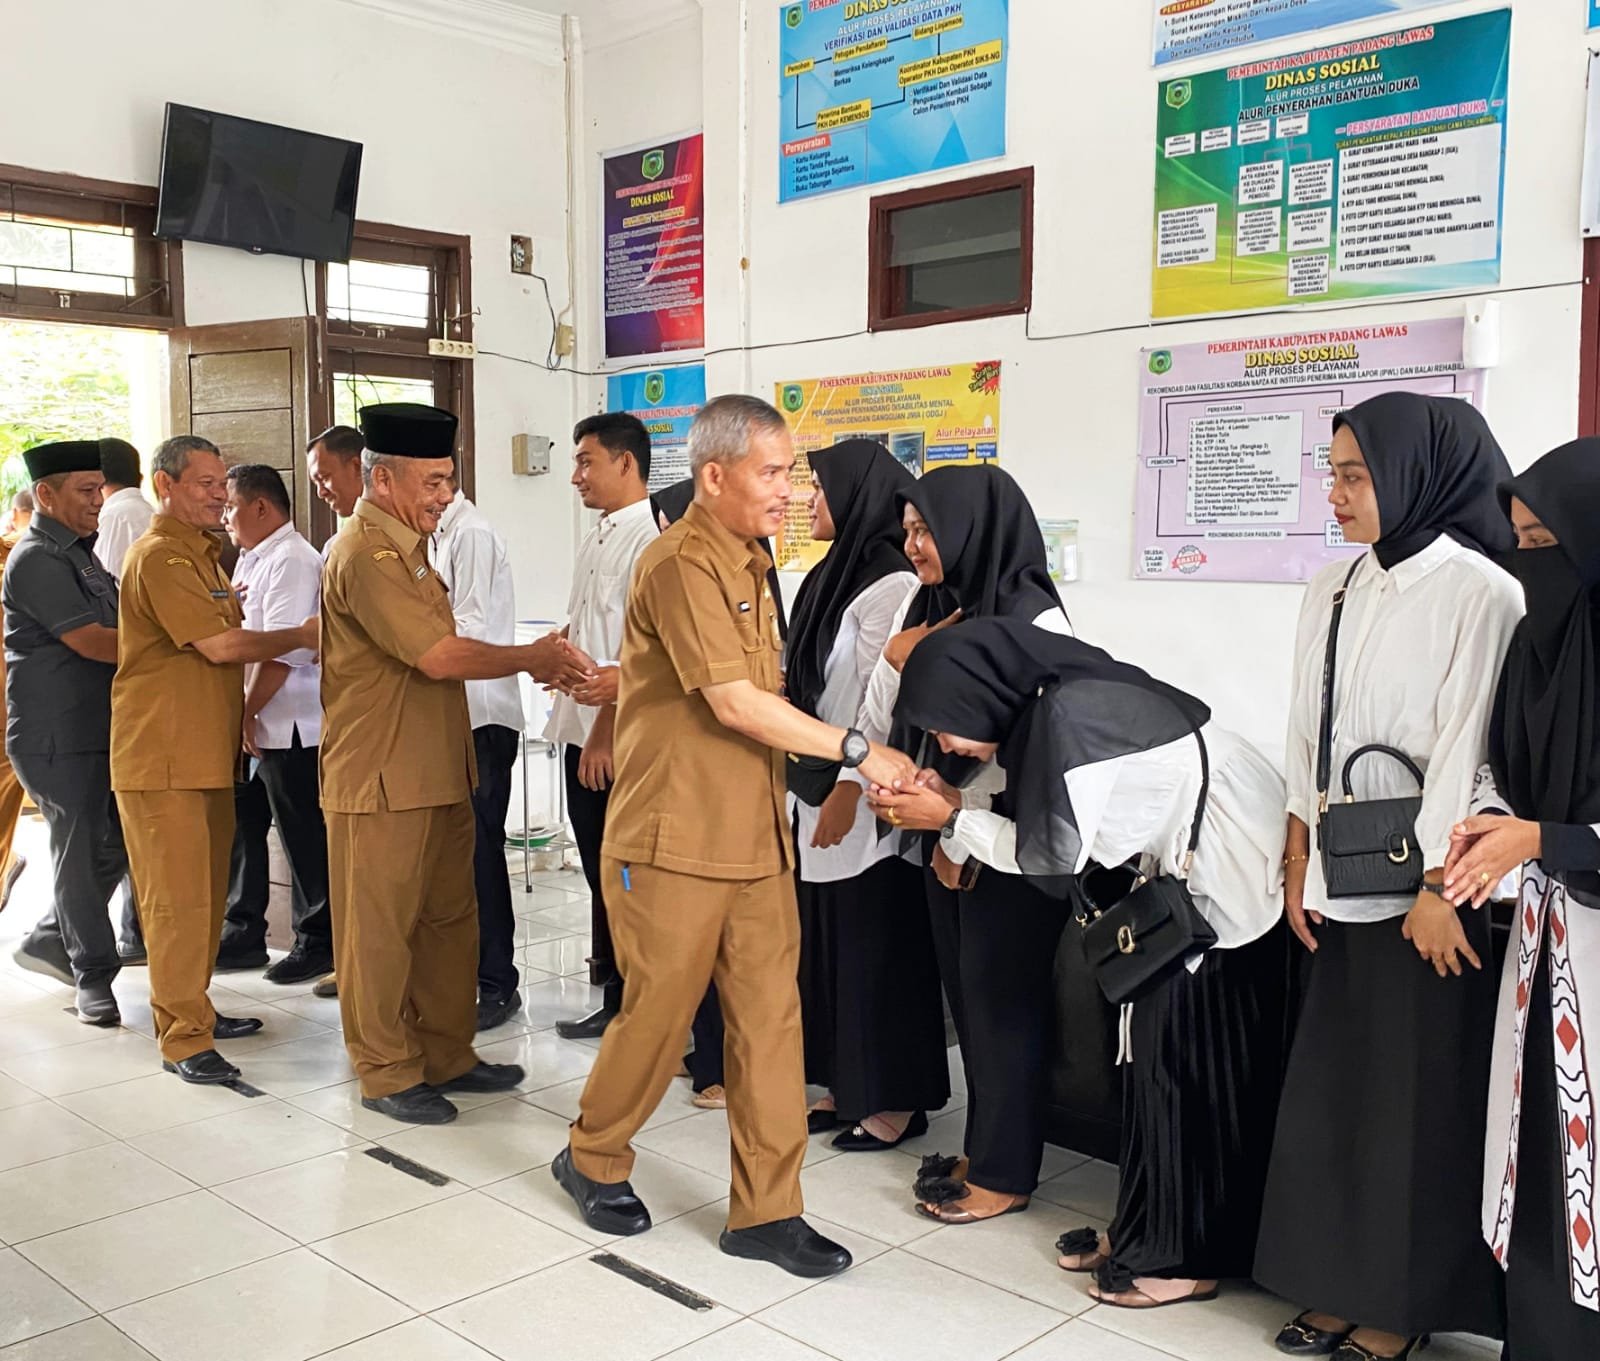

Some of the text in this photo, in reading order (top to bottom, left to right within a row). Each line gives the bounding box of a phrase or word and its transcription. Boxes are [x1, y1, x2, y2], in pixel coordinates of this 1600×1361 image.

[844, 0, 888, 21] DINAS
[1171, 16, 1188, 26] Surat
[1190, 6, 1226, 22] Keterangan
[1227, 0, 1251, 13] Kurang
[1171, 27, 1188, 37] Surat
[1190, 18, 1226, 34] Keterangan
[1227, 12, 1249, 23] Miskin
[1250, 8, 1264, 19] Dari
[1265, 2, 1288, 15] Kepala
[824, 33, 865, 51] VERIFIKASI
[868, 28, 883, 39] DAN
[885, 18, 920, 33] VALIDASI
[922, 11, 943, 23] DATA
[945, 3, 962, 16] PKH
[838, 22, 859, 35] ALUR
[862, 13, 896, 27] PROSES
[1170, 38, 1185, 48] Foto
[1186, 34, 1202, 46] Copy
[1204, 29, 1221, 39] Kartu
[1223, 23, 1252, 36] Keluarga
[1184, 46, 1201, 56] Kartu
[1202, 41, 1221, 51] Tanda
[1223, 33, 1255, 47] Penduduk
[856, 40, 886, 54] Pendaftaran
[1227, 26, 1435, 81] PEMERINTAH KABUPATEN PADANG LAWAS
[788, 62, 810, 73] Pemohon
[862, 56, 895, 70] Kelengkapan
[900, 48, 976, 74] Koordinator Kabupaten PKH
[900, 72, 923, 84] Operator
[924, 69, 936, 79] PKH
[938, 65, 948, 74] Dan
[1265, 54, 1381, 91] DINAS SOSIAL
[913, 71, 988, 96] Verifikasi Dan Validasi Data
[946, 84, 969, 97] Kembali
[1264, 72, 1384, 104] ALUR PROSES PELAYANAN
[913, 95, 970, 116] Calon Penerima PKH
[1238, 75, 1420, 122] ALUR PENYERAHAN BANTUAN DUKA
[817, 121, 828, 129] PKH
[840, 110, 870, 124] KEMENSOS
[841, 104, 862, 116] Bantuan
[1346, 112, 1410, 137] PERSYARATAN
[1412, 105, 1458, 124] BANTUAN
[1459, 100, 1488, 116] DUKA
[786, 137, 826, 155] Persyaratan
[796, 151, 831, 164] Kartu Keluarga
[796, 155, 849, 174] Kartu Tanda Penduduk
[796, 174, 809, 183] Kartu
[810, 170, 831, 181] Keluarga
[796, 179, 832, 193] Buku Tabungan
[631, 188, 675, 209] DINAS SOSIAL
[1208, 324, 1409, 354] PEMERINTAH KABUPATEN PADANG LAWAS
[1245, 344, 1359, 368] DINAS SOSIAL
[820, 368, 952, 388] PEMERINTAH KABUPATEN PADANG LAWAS
[1147, 386, 1184, 395] REKOMENDASI
[1185, 384, 1196, 392] DAN
[1197, 382, 1226, 392] FASILITASI
[1226, 380, 1250, 389] KORBAN
[1280, 375, 1306, 385] INSTITUSI
[1307, 373, 1337, 383] PENERIMA
[1338, 371, 1357, 380] WAJIB
[1358, 370, 1379, 379] LAPOR
[1400, 366, 1414, 376] DAN
[1415, 365, 1434, 375] BALAI
[1244, 361, 1360, 378] ALUR PROSES PELAYANAN
[844, 394, 921, 406] ALUR PROSES PELAYANAN
[851, 404, 891, 414] PENYANDANG
[892, 401, 929, 411] DISABILITAS
[929, 399, 955, 408] MENTAL
[826, 410, 944, 426] ORANG DENGAN GANGGUAN JIWA ODGJ
[936, 426, 997, 439] Alur Pelayanan
